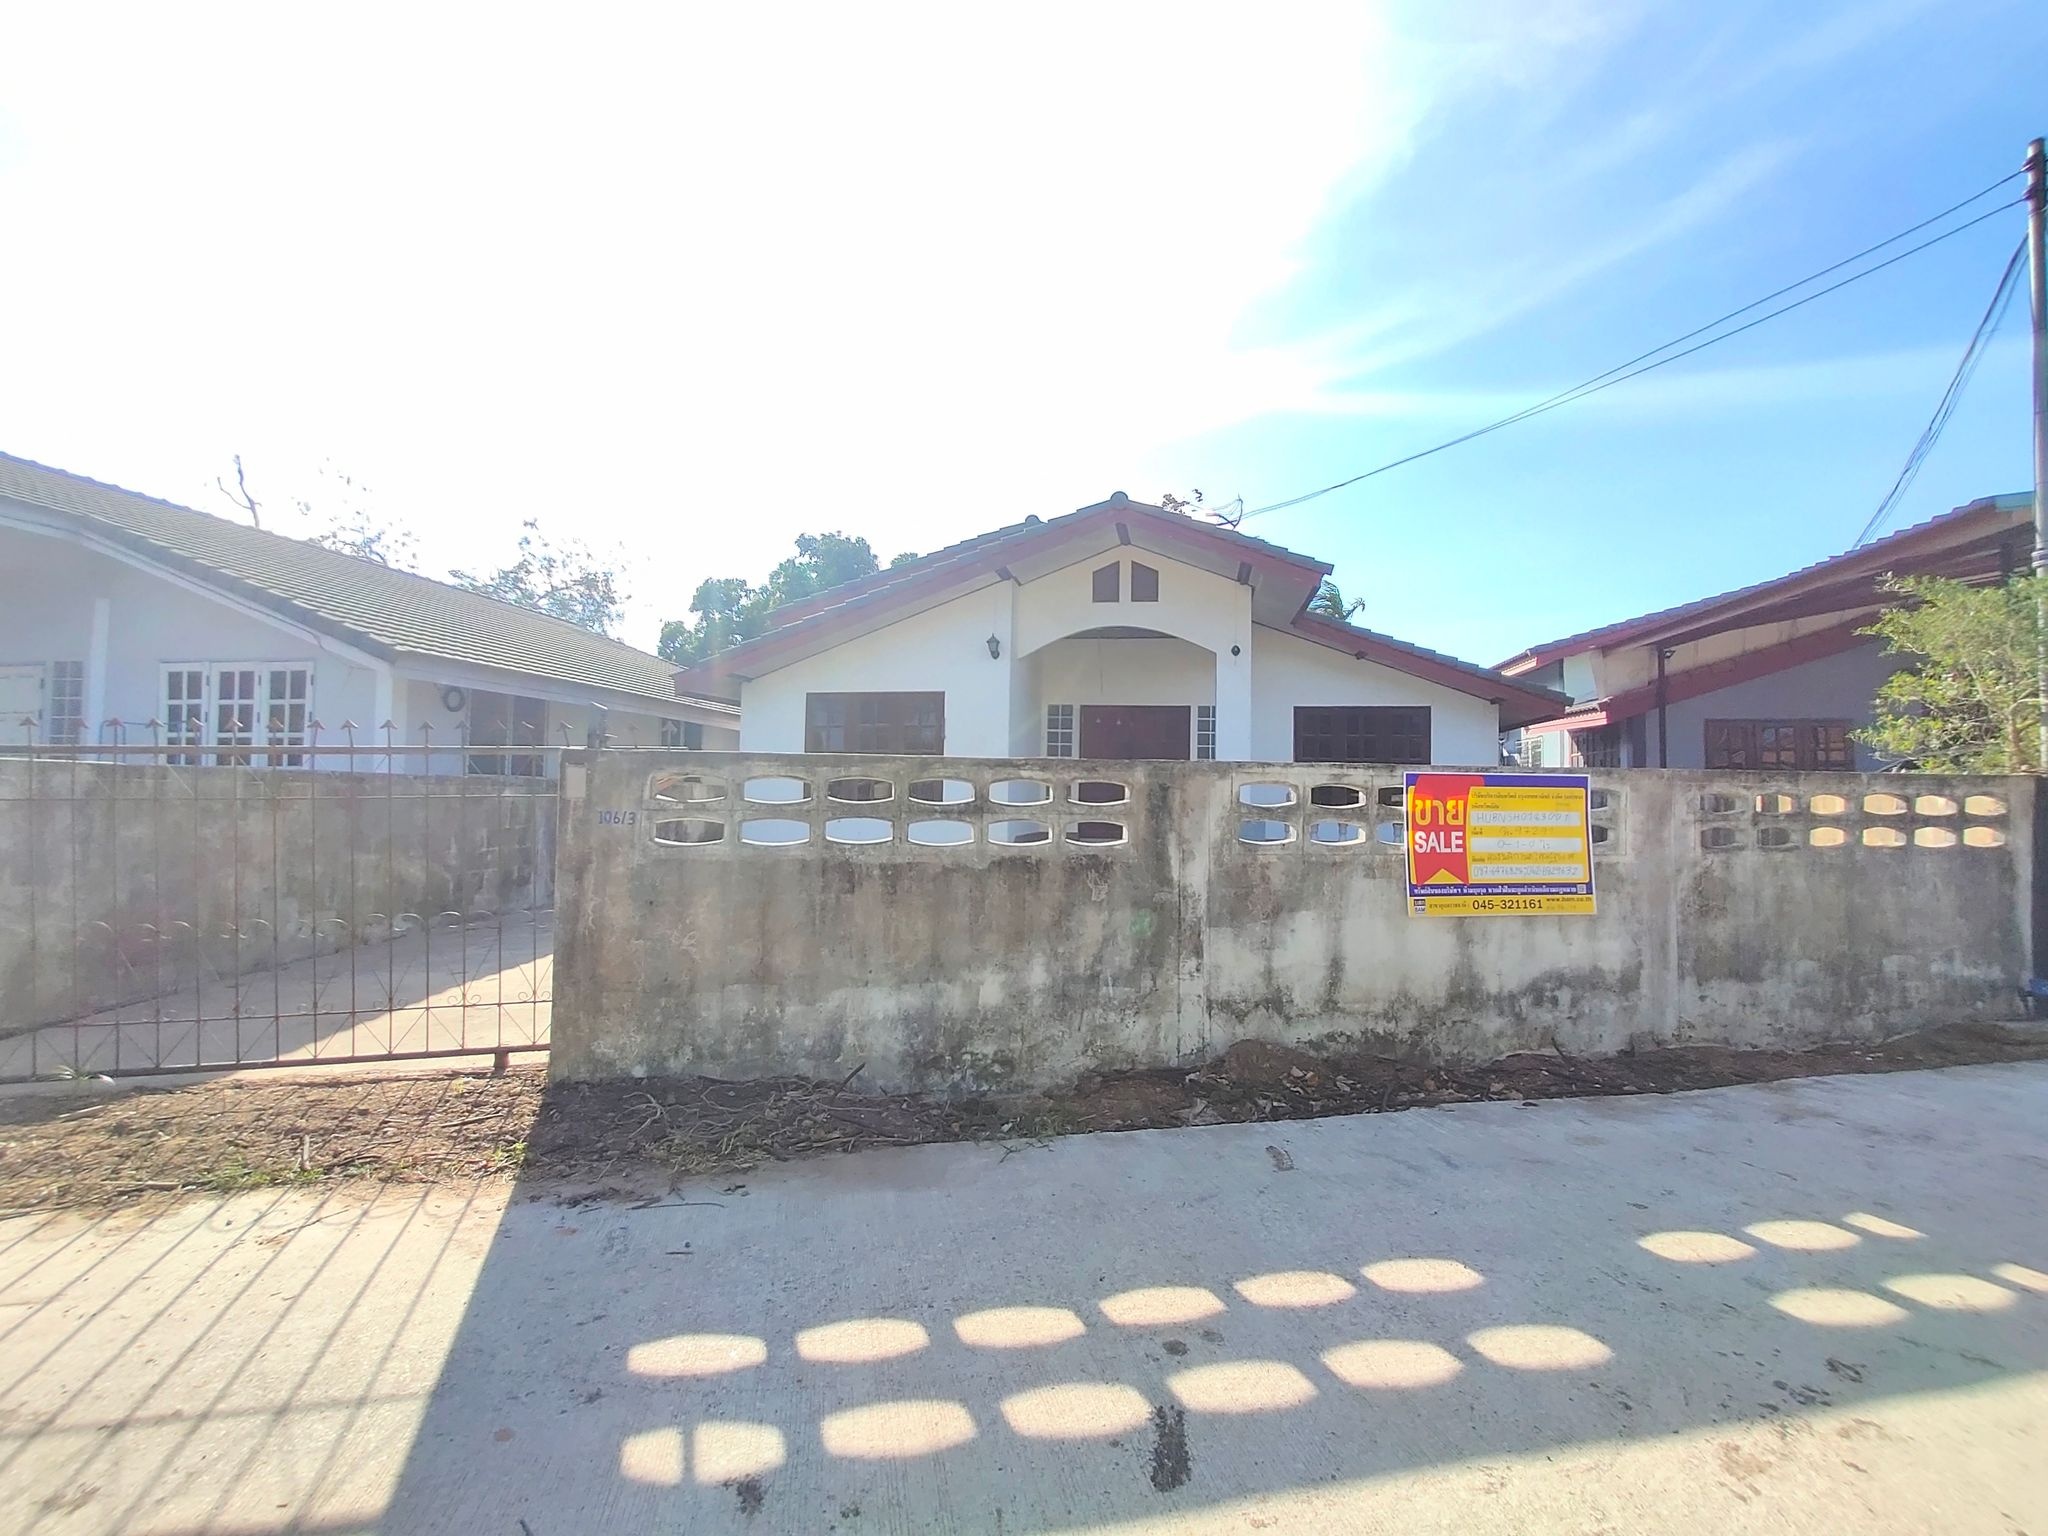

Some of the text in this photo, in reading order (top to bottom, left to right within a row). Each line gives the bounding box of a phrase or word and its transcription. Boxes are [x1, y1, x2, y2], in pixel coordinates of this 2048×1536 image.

[598, 810, 637, 825] 106/3
[1414, 799, 1464, 826] ขาย
[1414, 831, 1463, 853] SALE
[1472, 899, 1543, 910] 045-321161
